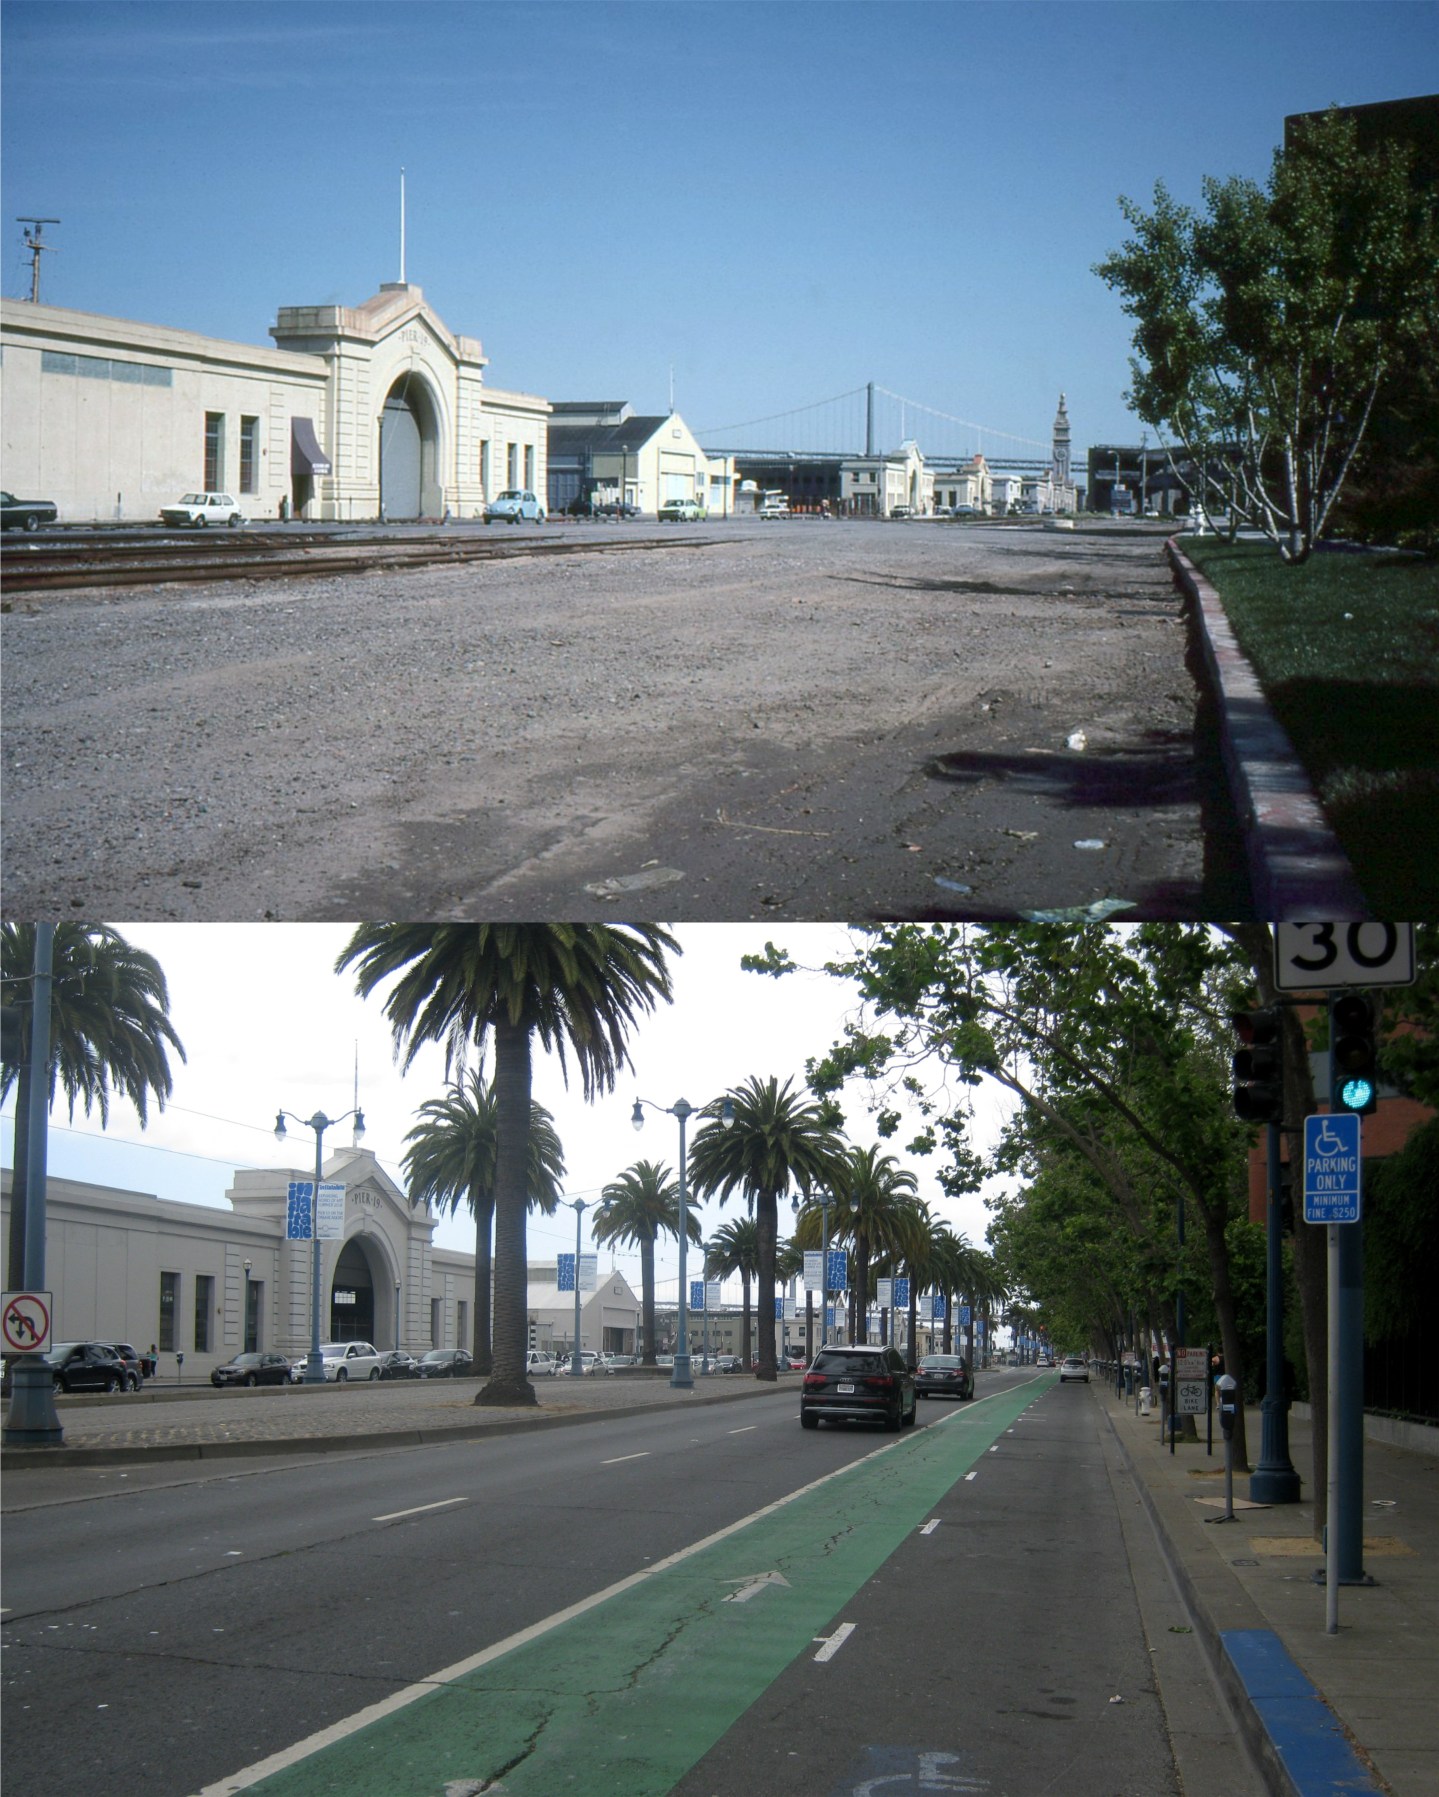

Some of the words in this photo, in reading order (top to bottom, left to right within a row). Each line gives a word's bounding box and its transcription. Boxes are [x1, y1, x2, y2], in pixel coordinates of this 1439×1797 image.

[1290, 922, 1397, 971] 30
[1308, 1157, 1356, 1173] PARKING
[1317, 1174, 1347, 1190] ONLY
[354, 1192, 371, 1205] PIER
[373, 1198, 381, 1209] 19
[1313, 1195, 1350, 1206] MINIMUM
[1307, 1208, 1326, 1219] FINE
[1332, 1207, 1356, 1218] $250
